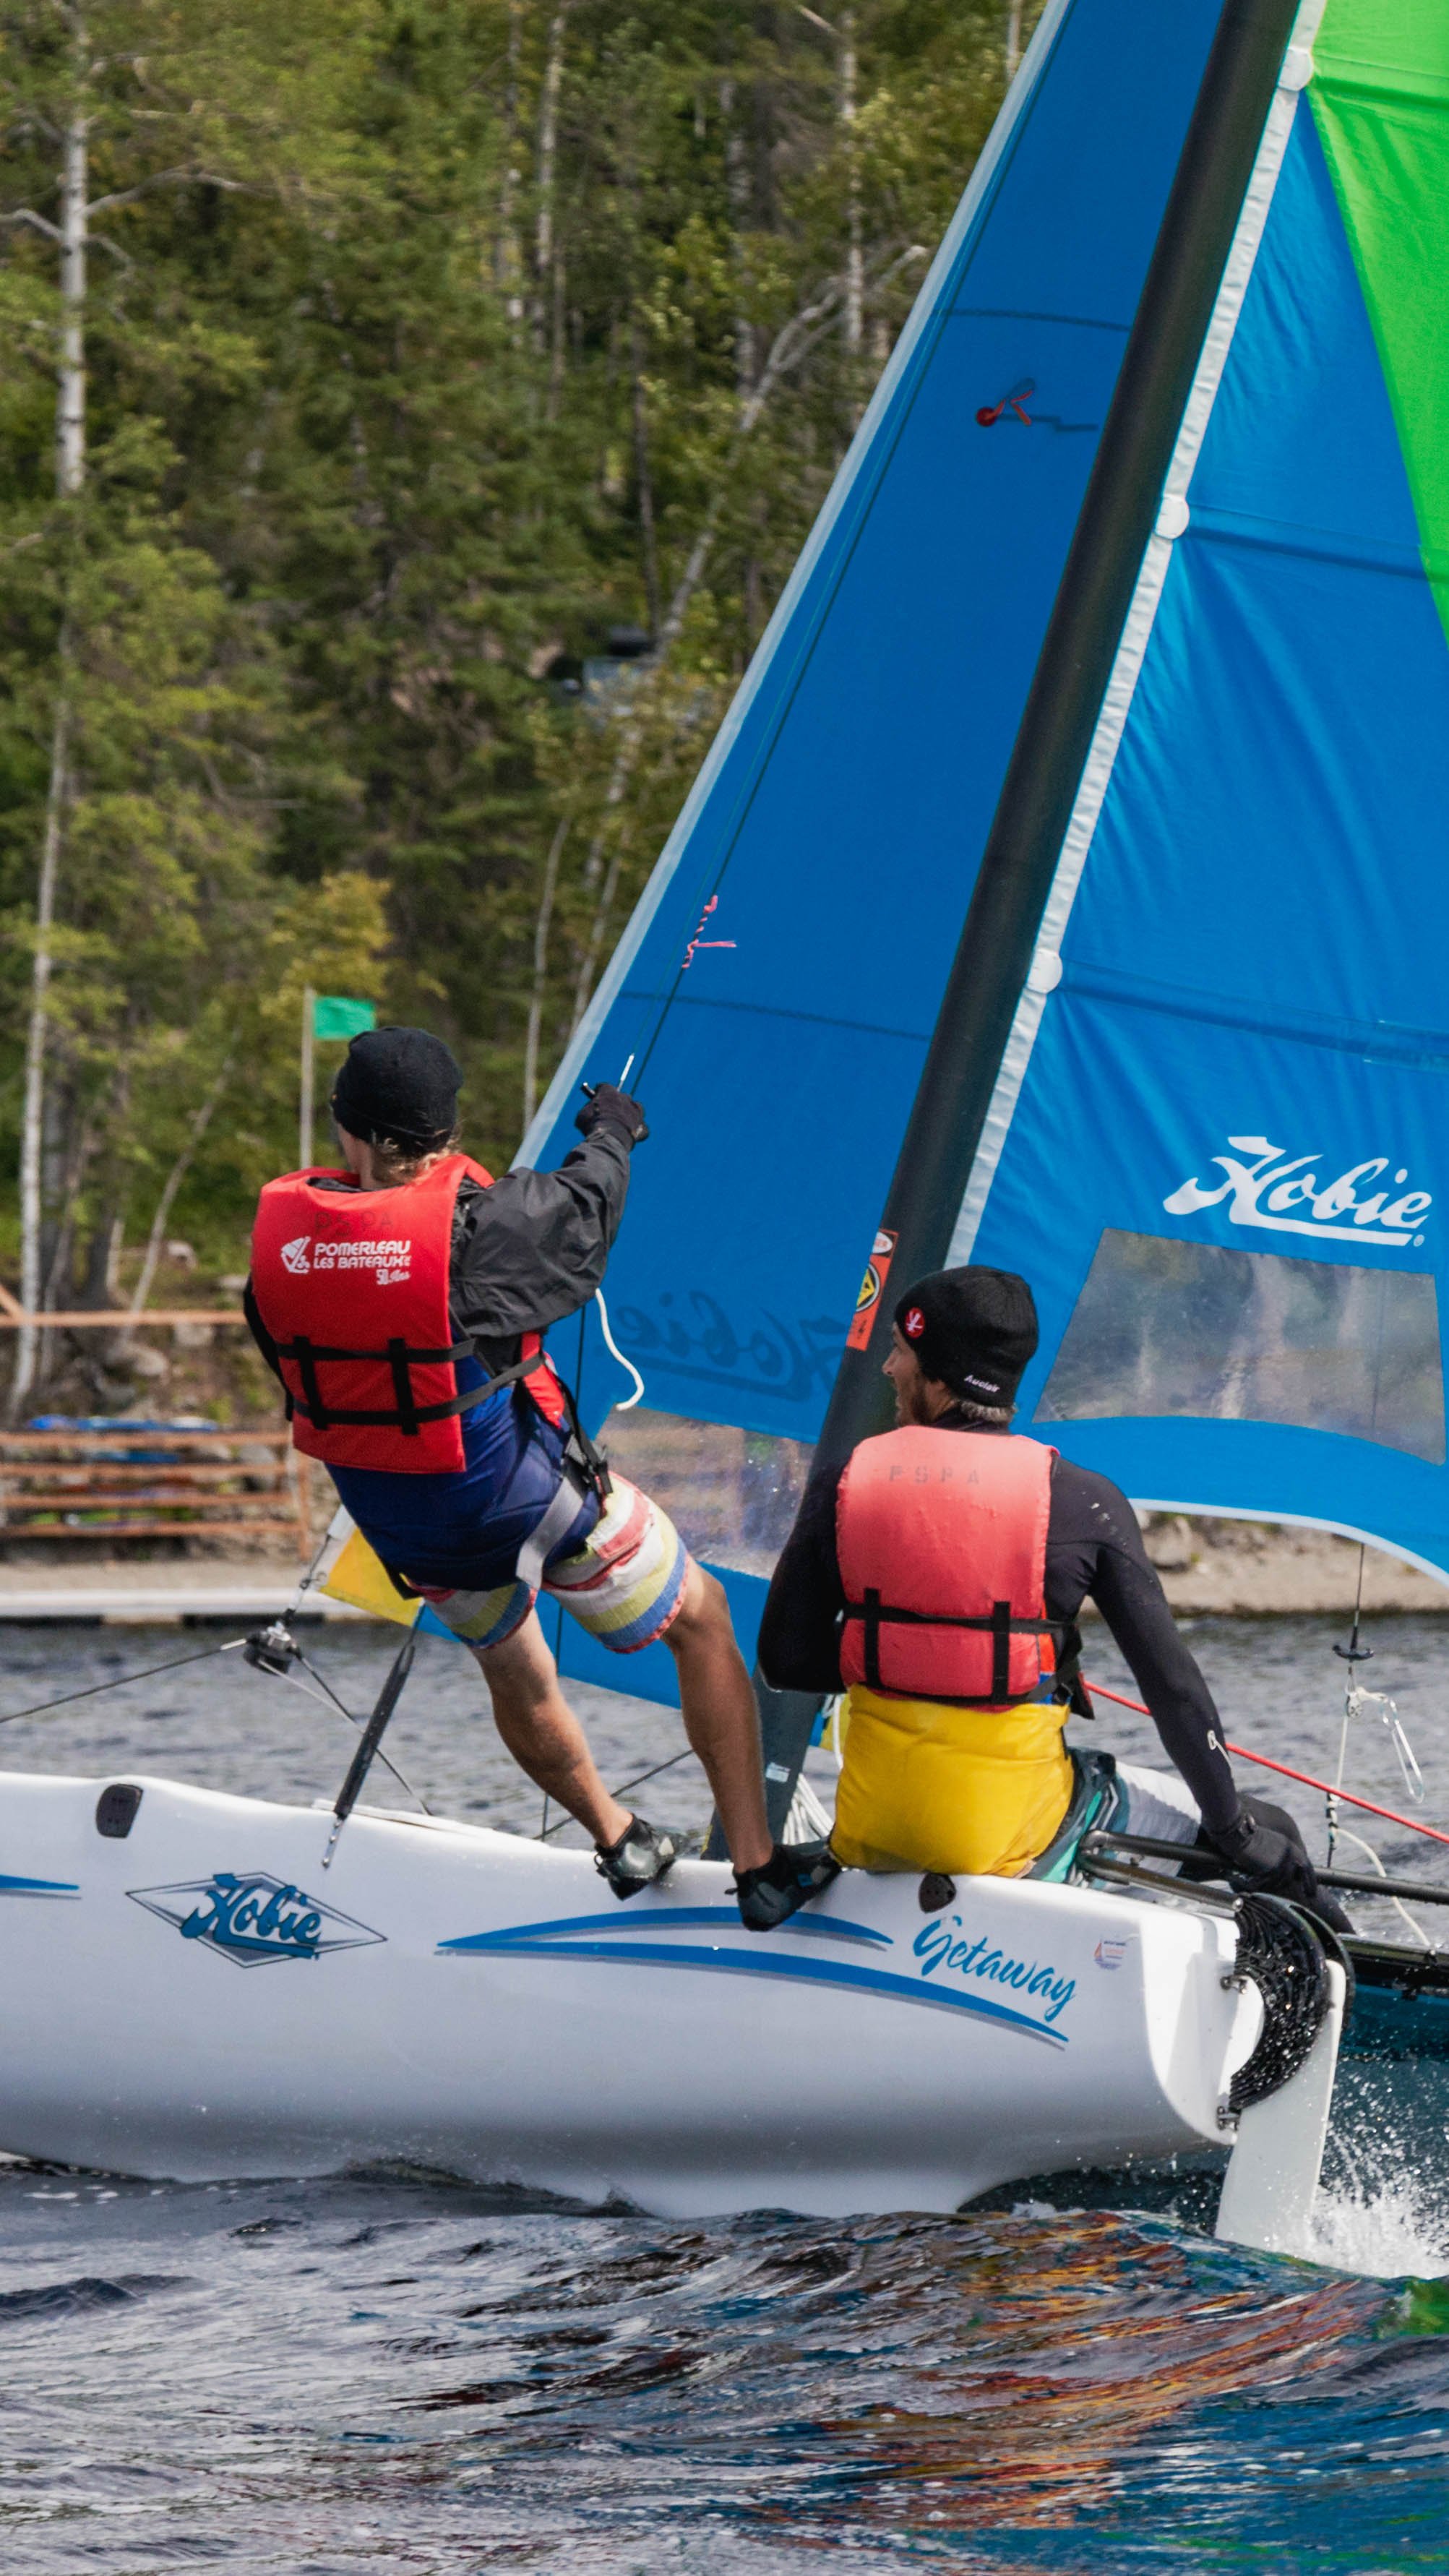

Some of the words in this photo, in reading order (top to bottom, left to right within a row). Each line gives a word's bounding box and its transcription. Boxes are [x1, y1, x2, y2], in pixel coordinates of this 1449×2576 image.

[1163, 1136, 1432, 1246] Hobie
[313, 1257, 335, 1269] LES
[337, 1256, 404, 1269] BATEAUX
[314, 1240, 411, 1256] POMERLEAU
[181, 1873, 320, 1959] Hobie
[913, 1915, 1075, 2022] Getaway
